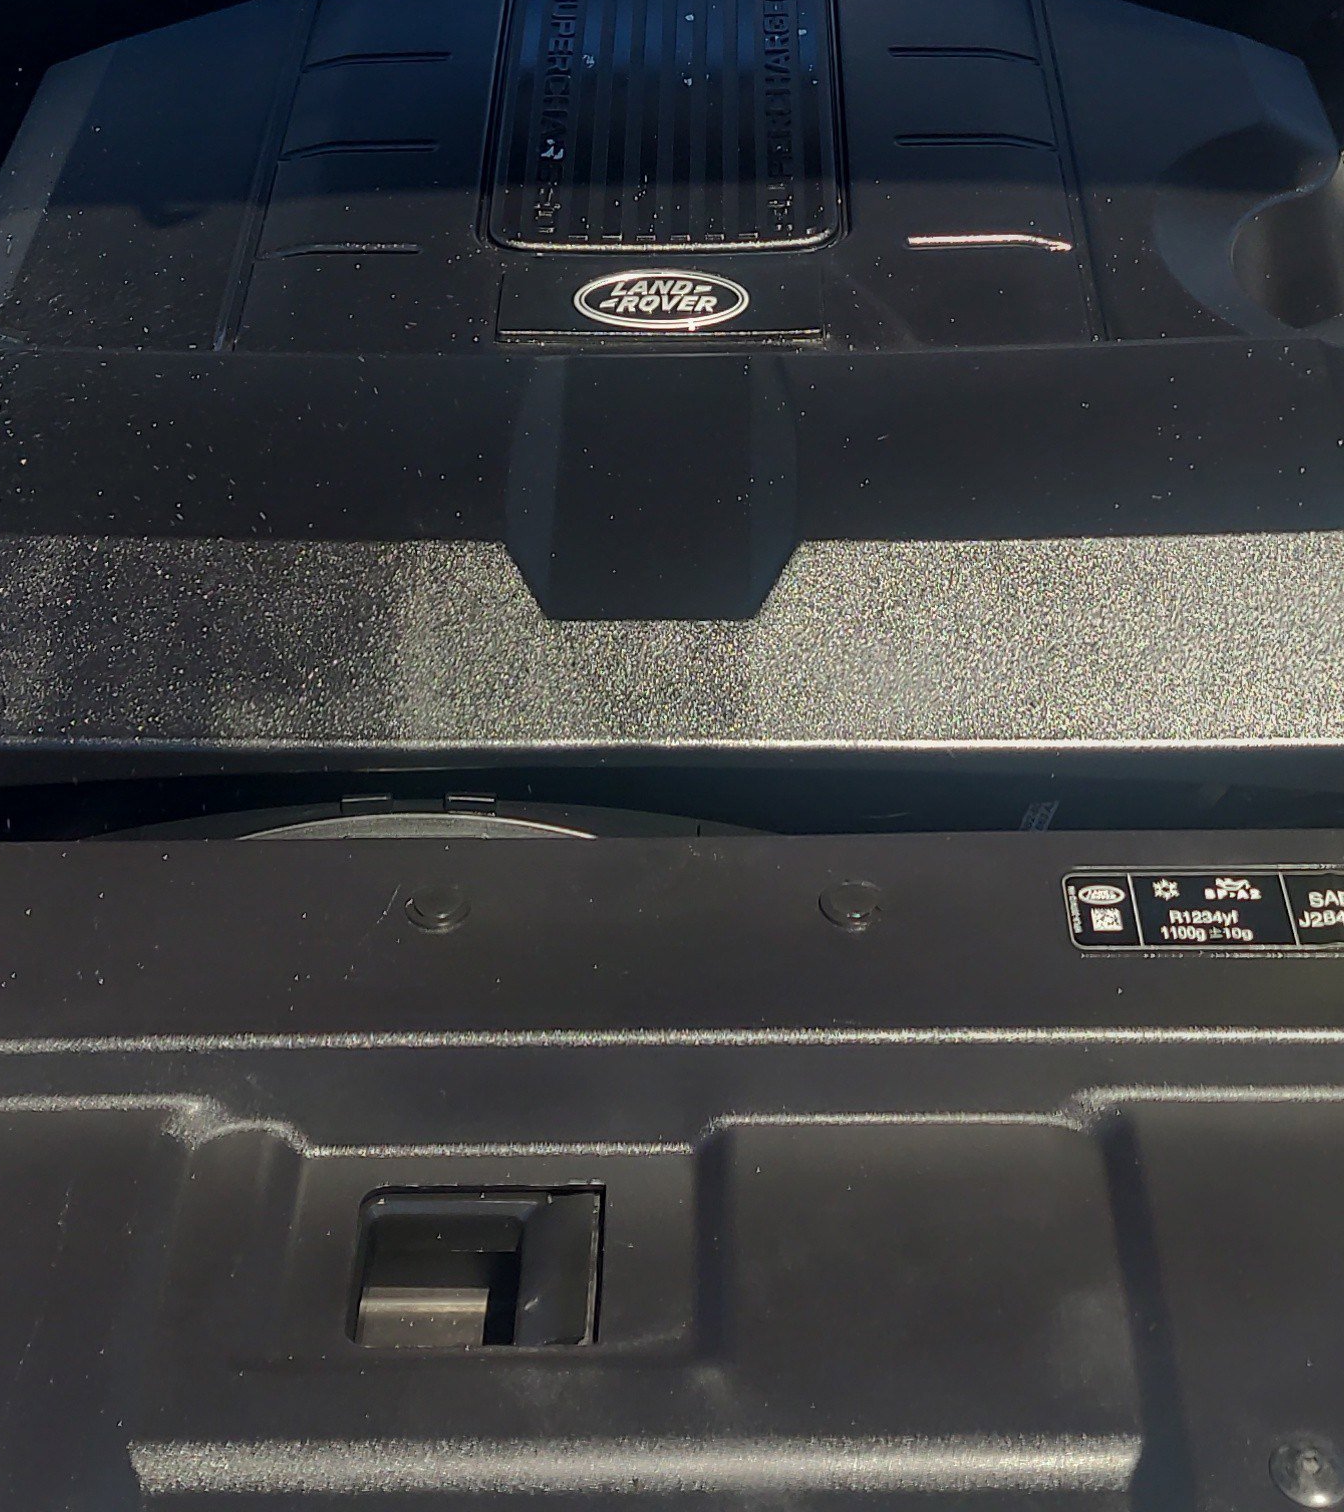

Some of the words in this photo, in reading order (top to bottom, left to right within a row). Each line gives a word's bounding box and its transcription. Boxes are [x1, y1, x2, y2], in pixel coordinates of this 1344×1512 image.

[610, 280, 692, 296] LAND
[615, 295, 718, 313] ROVER
[1169, 909, 1239, 927] R1234yf
[1160, 925, 1208, 942] 1100g
